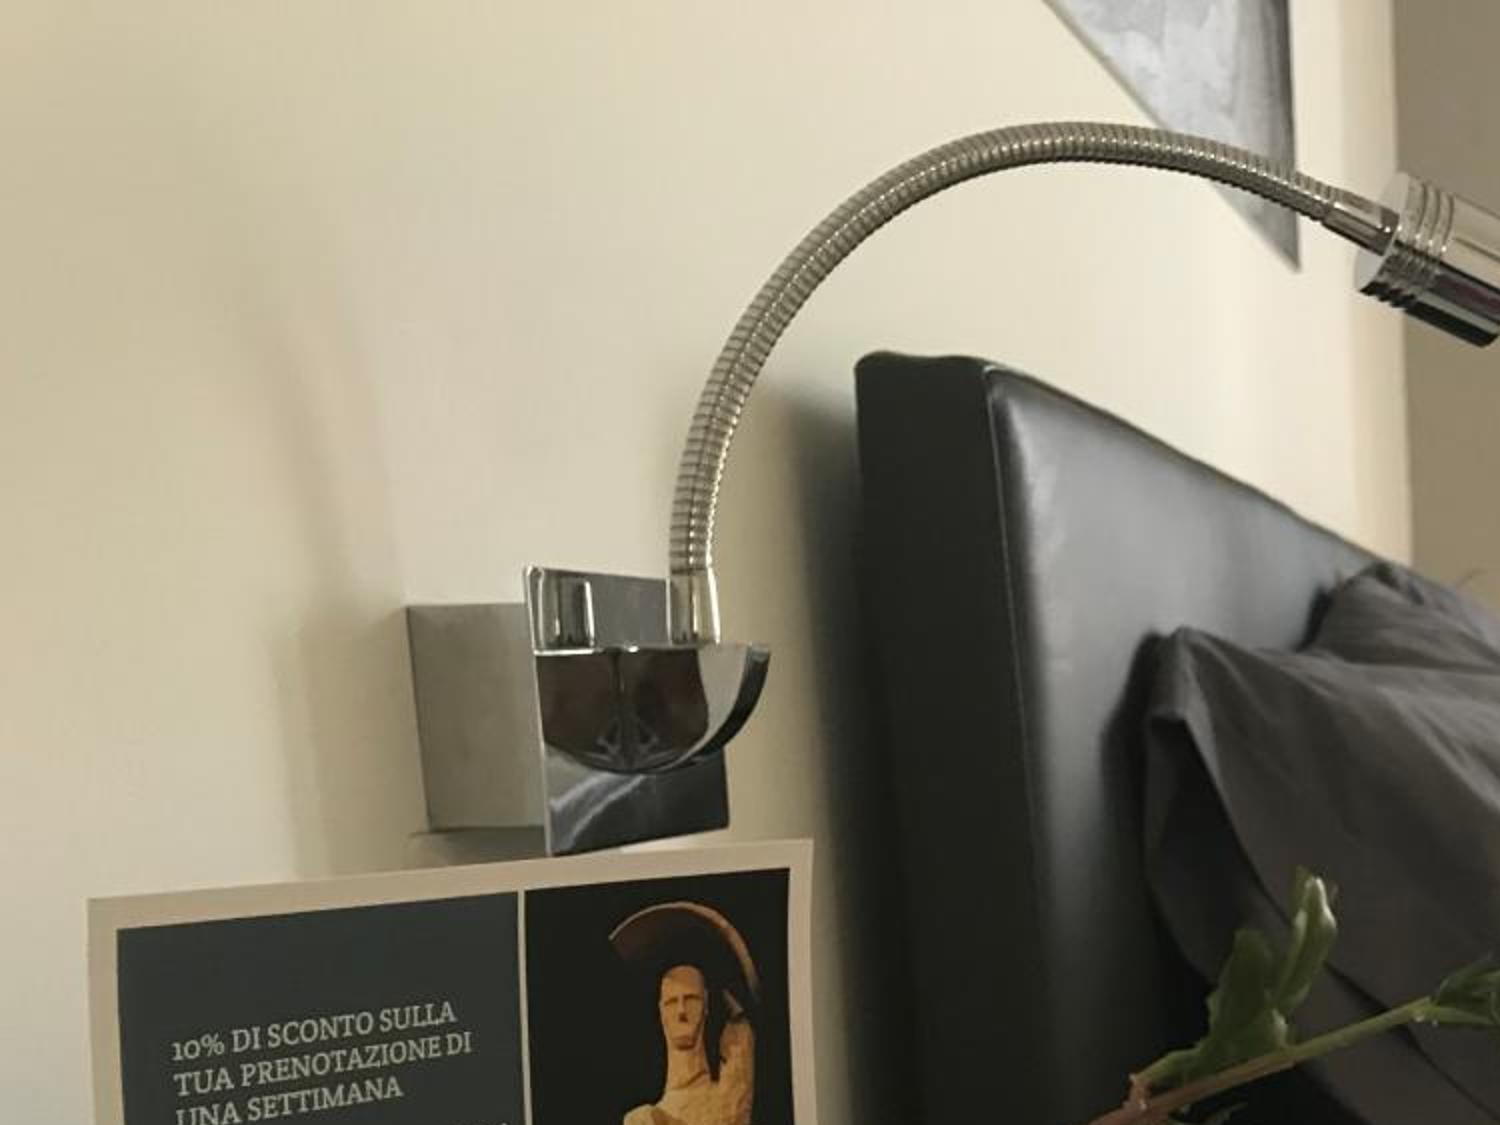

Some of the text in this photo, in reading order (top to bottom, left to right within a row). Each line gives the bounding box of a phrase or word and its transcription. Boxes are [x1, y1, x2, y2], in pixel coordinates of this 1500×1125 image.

[172, 1001, 458, 1061] 10% DI SCONTO SULLA
[173, 1031, 472, 1096] TUA PRENOTAZIONE DI
[248, 1075, 404, 1121] SETTIMANA
